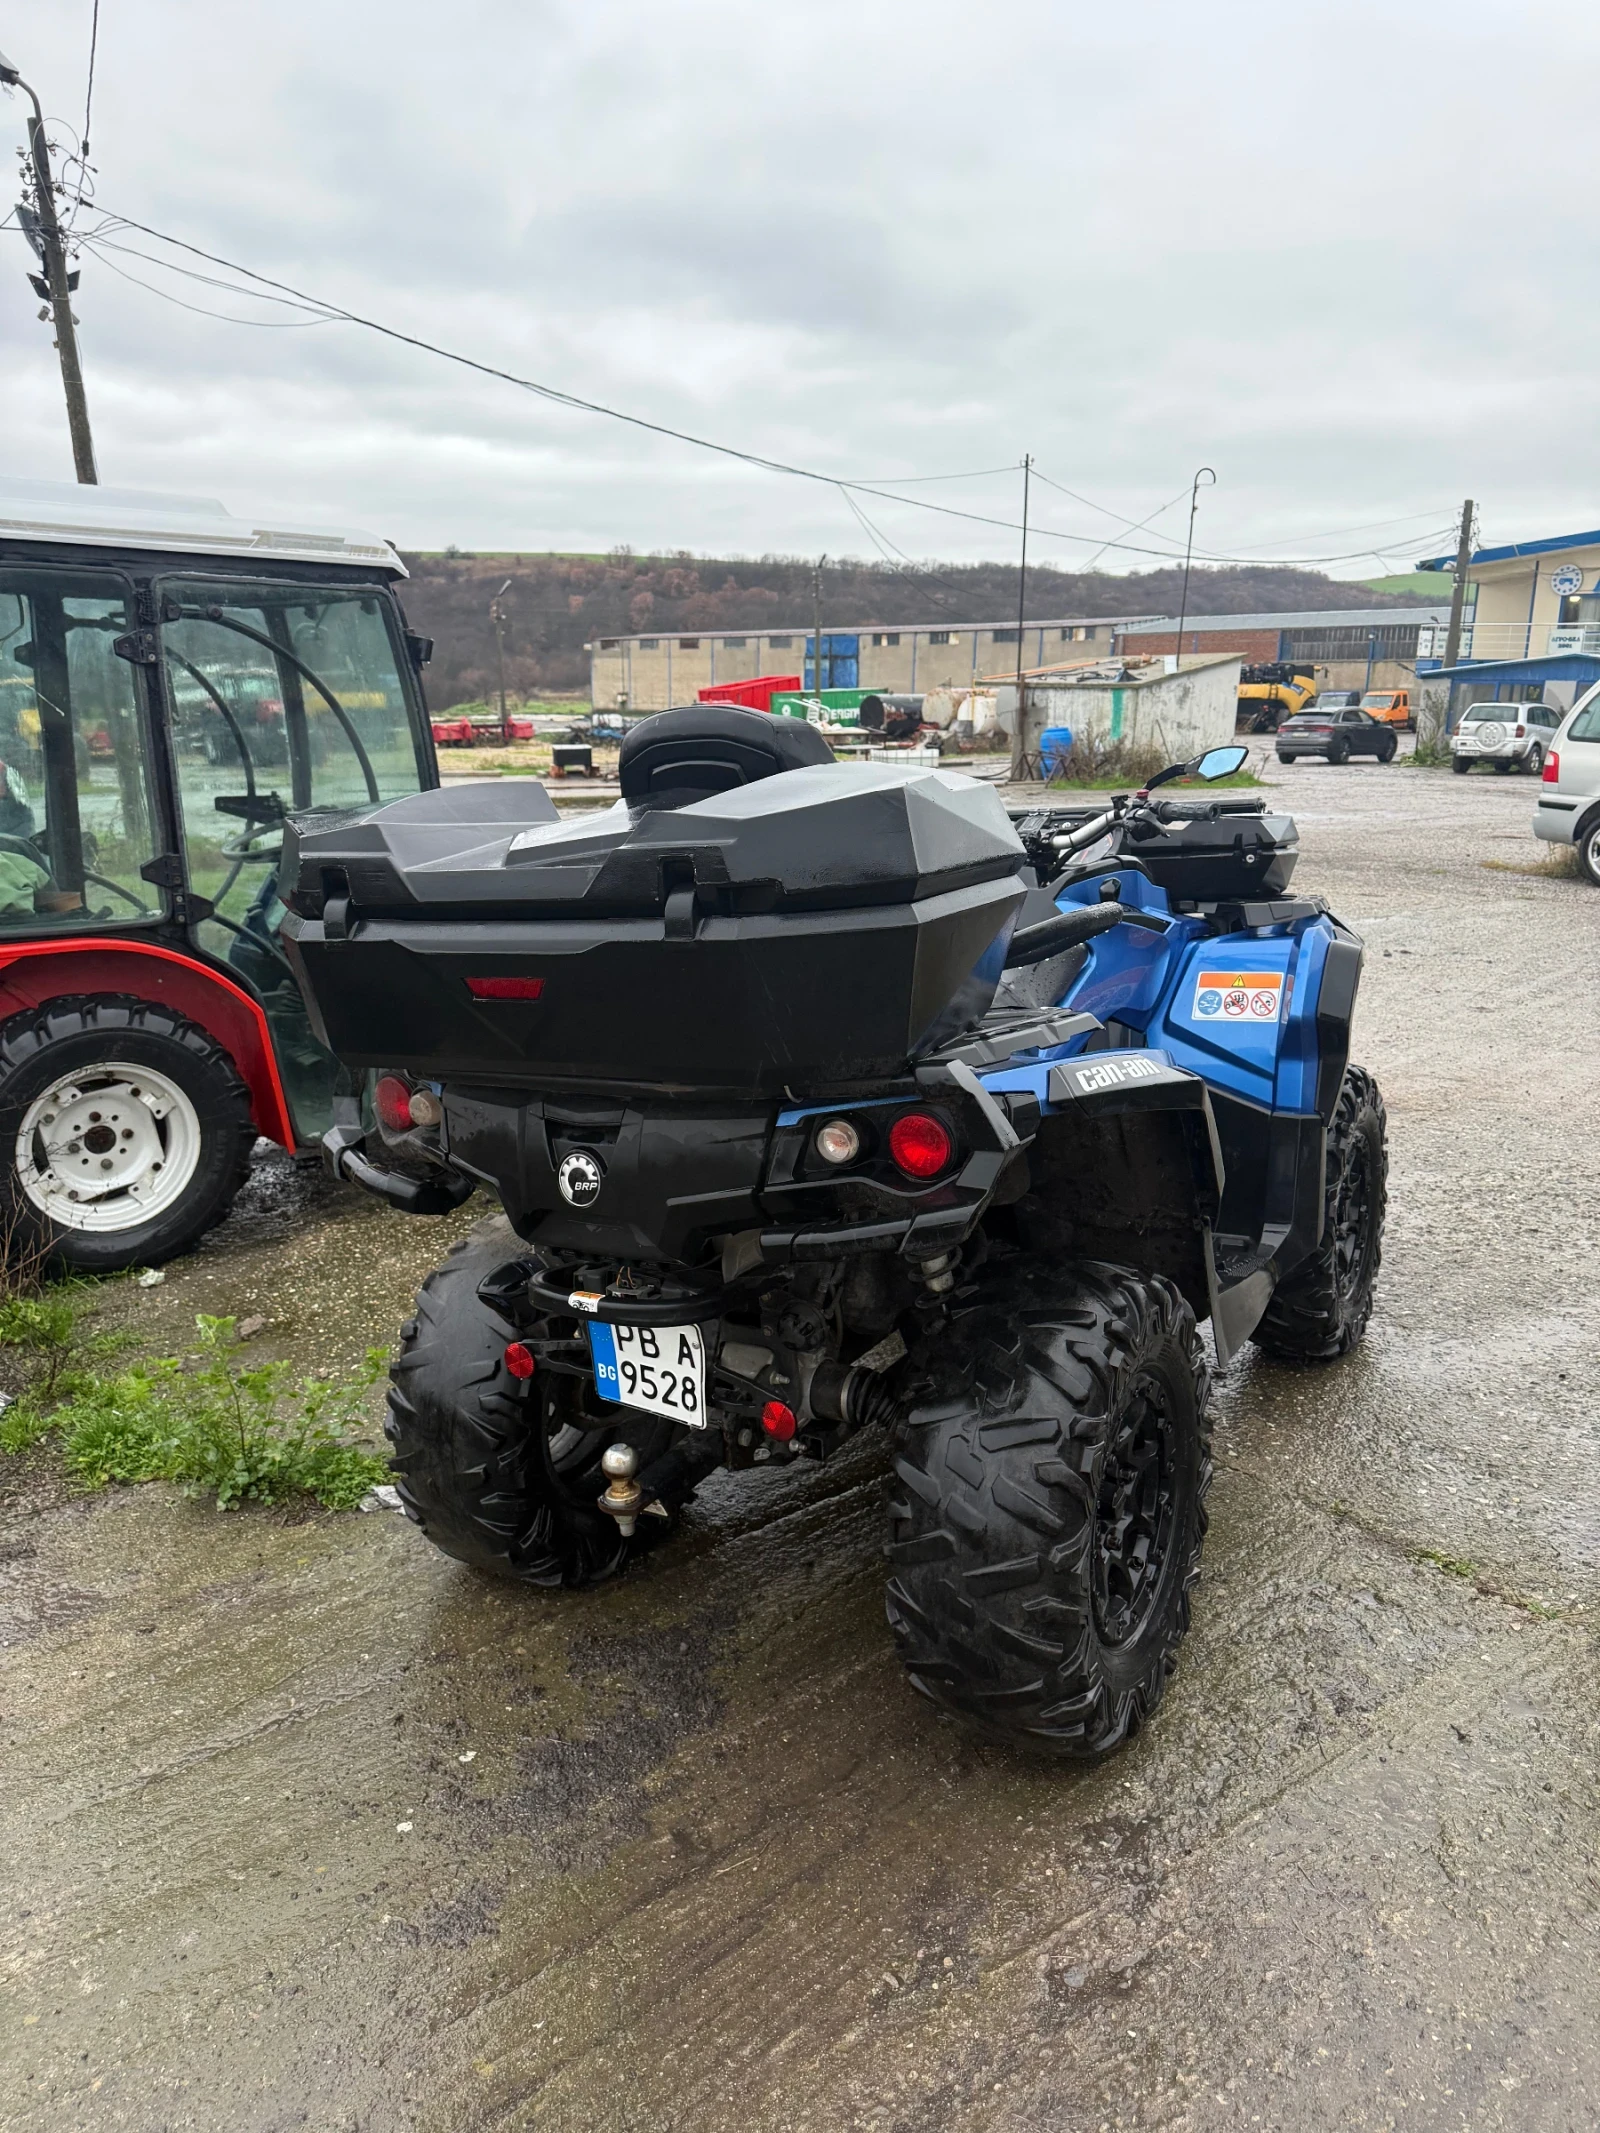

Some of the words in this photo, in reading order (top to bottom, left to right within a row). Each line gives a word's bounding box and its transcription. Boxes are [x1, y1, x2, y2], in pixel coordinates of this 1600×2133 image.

[1075, 1058, 1161, 1092] can-am
[574, 1181, 598, 1191] BRP
[677, 1333, 696, 1369] A
[598, 1363, 617, 1381] BG
[620, 1360, 698, 1412] 9528
